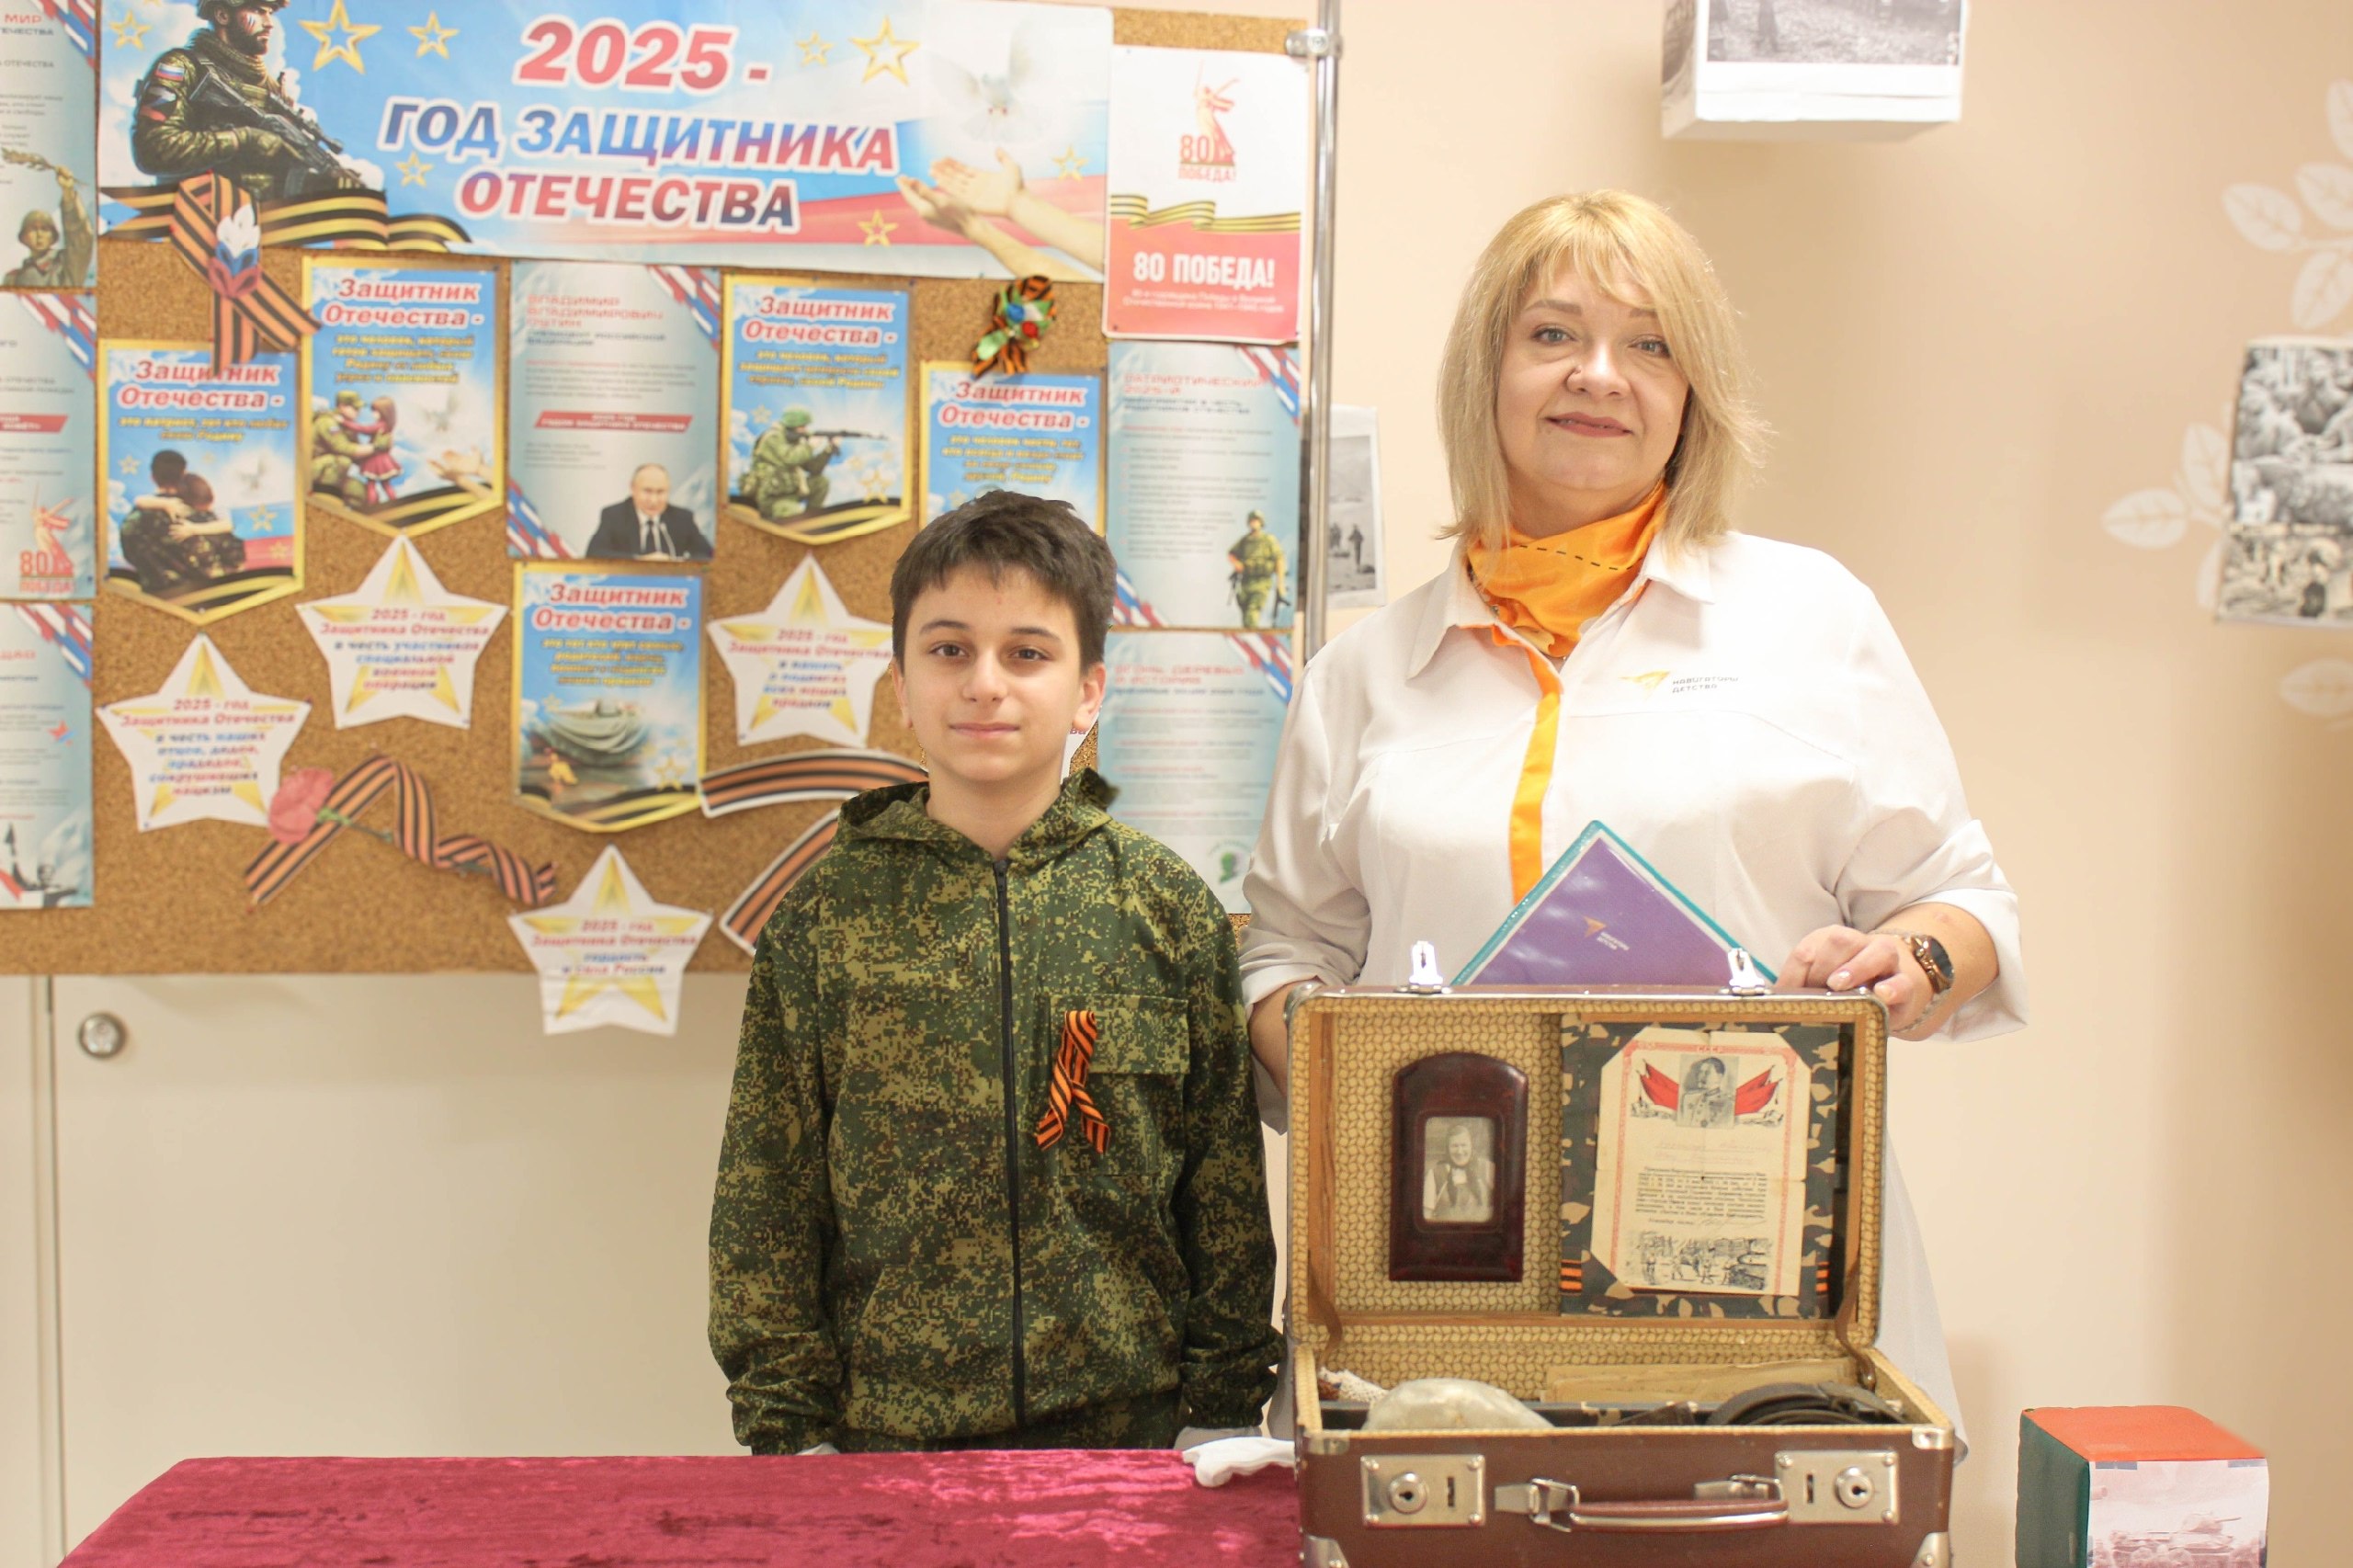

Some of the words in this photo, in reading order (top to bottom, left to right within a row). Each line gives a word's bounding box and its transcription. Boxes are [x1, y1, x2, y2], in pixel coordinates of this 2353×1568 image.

[5, 14, 41, 24] МИР
[517, 20, 736, 90] 2025
[384, 103, 498, 158] ГОД
[517, 109, 895, 172] ЗАЩИТНИКА
[460, 171, 797, 229] ОТЕЧЕСТВА
[1133, 252, 1165, 283] 80
[1173, 254, 1275, 290] ПОБЕДА!
[339, 278, 481, 301] Защитник
[324, 303, 466, 326] Отечества
[759, 295, 893, 320] Защитник
[745, 320, 879, 345] Отечества
[120, 386, 267, 409] Отечества
[956, 381, 1086, 404] Защитник
[941, 405, 1072, 429] Отечества
[550, 584, 686, 607] Защитник
[371, 608, 409, 620] 2025
[535, 608, 674, 631] Отечества
[321, 622, 406, 635] Защитника
[411, 623, 488, 636] Отечества
[174, 699, 211, 710] 2025
[120, 714, 210, 727] Защитника
[215, 714, 295, 726] Отечества
